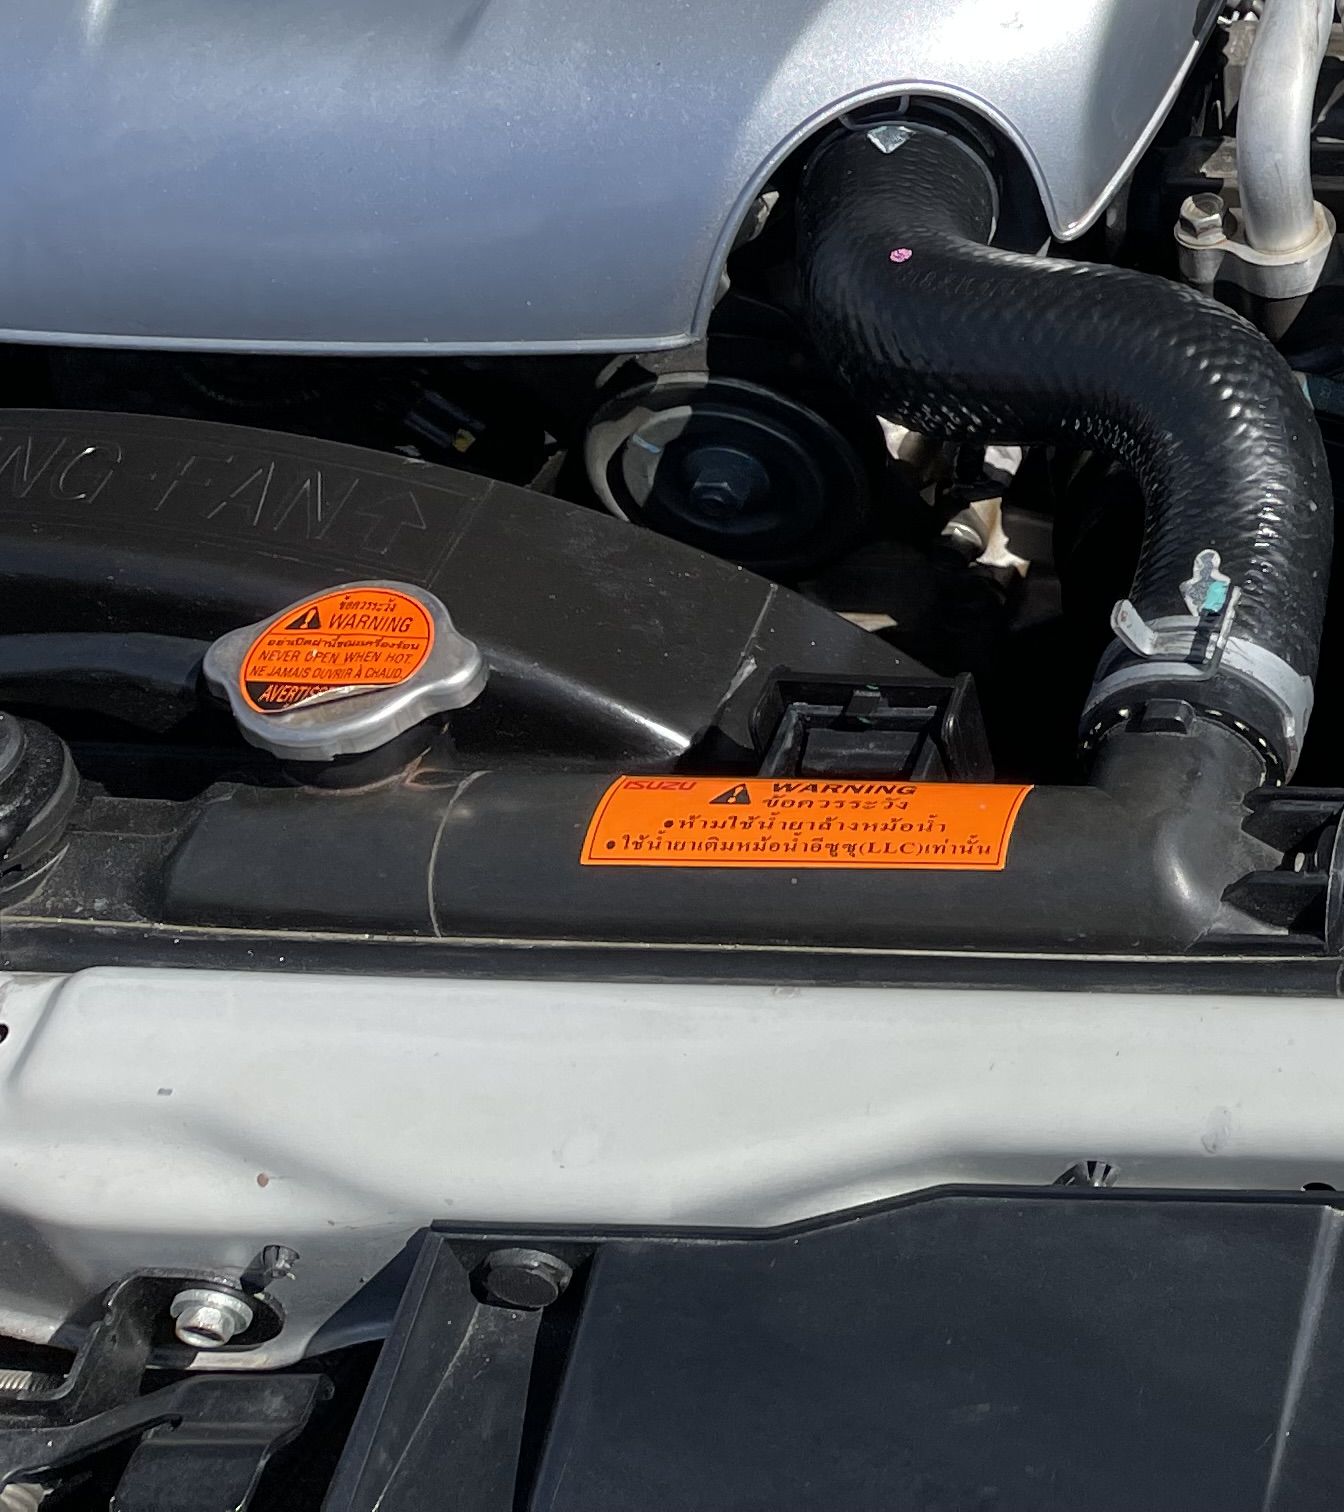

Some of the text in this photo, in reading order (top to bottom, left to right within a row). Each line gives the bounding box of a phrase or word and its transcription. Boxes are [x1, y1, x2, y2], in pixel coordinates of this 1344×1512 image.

[154, 454, 361, 541] FAN
[328, 612, 414, 634] WARNING
[258, 649, 414, 666] NEVER OPEN WHEN HOT.
[249, 662, 404, 680] NE JAMAIS OUVRIR À CHAUD.
[623, 779, 699, 792] ISUZU
[772, 782, 918, 796] WARNING
[762, 793, 910, 811] ข้อควรระวัง
